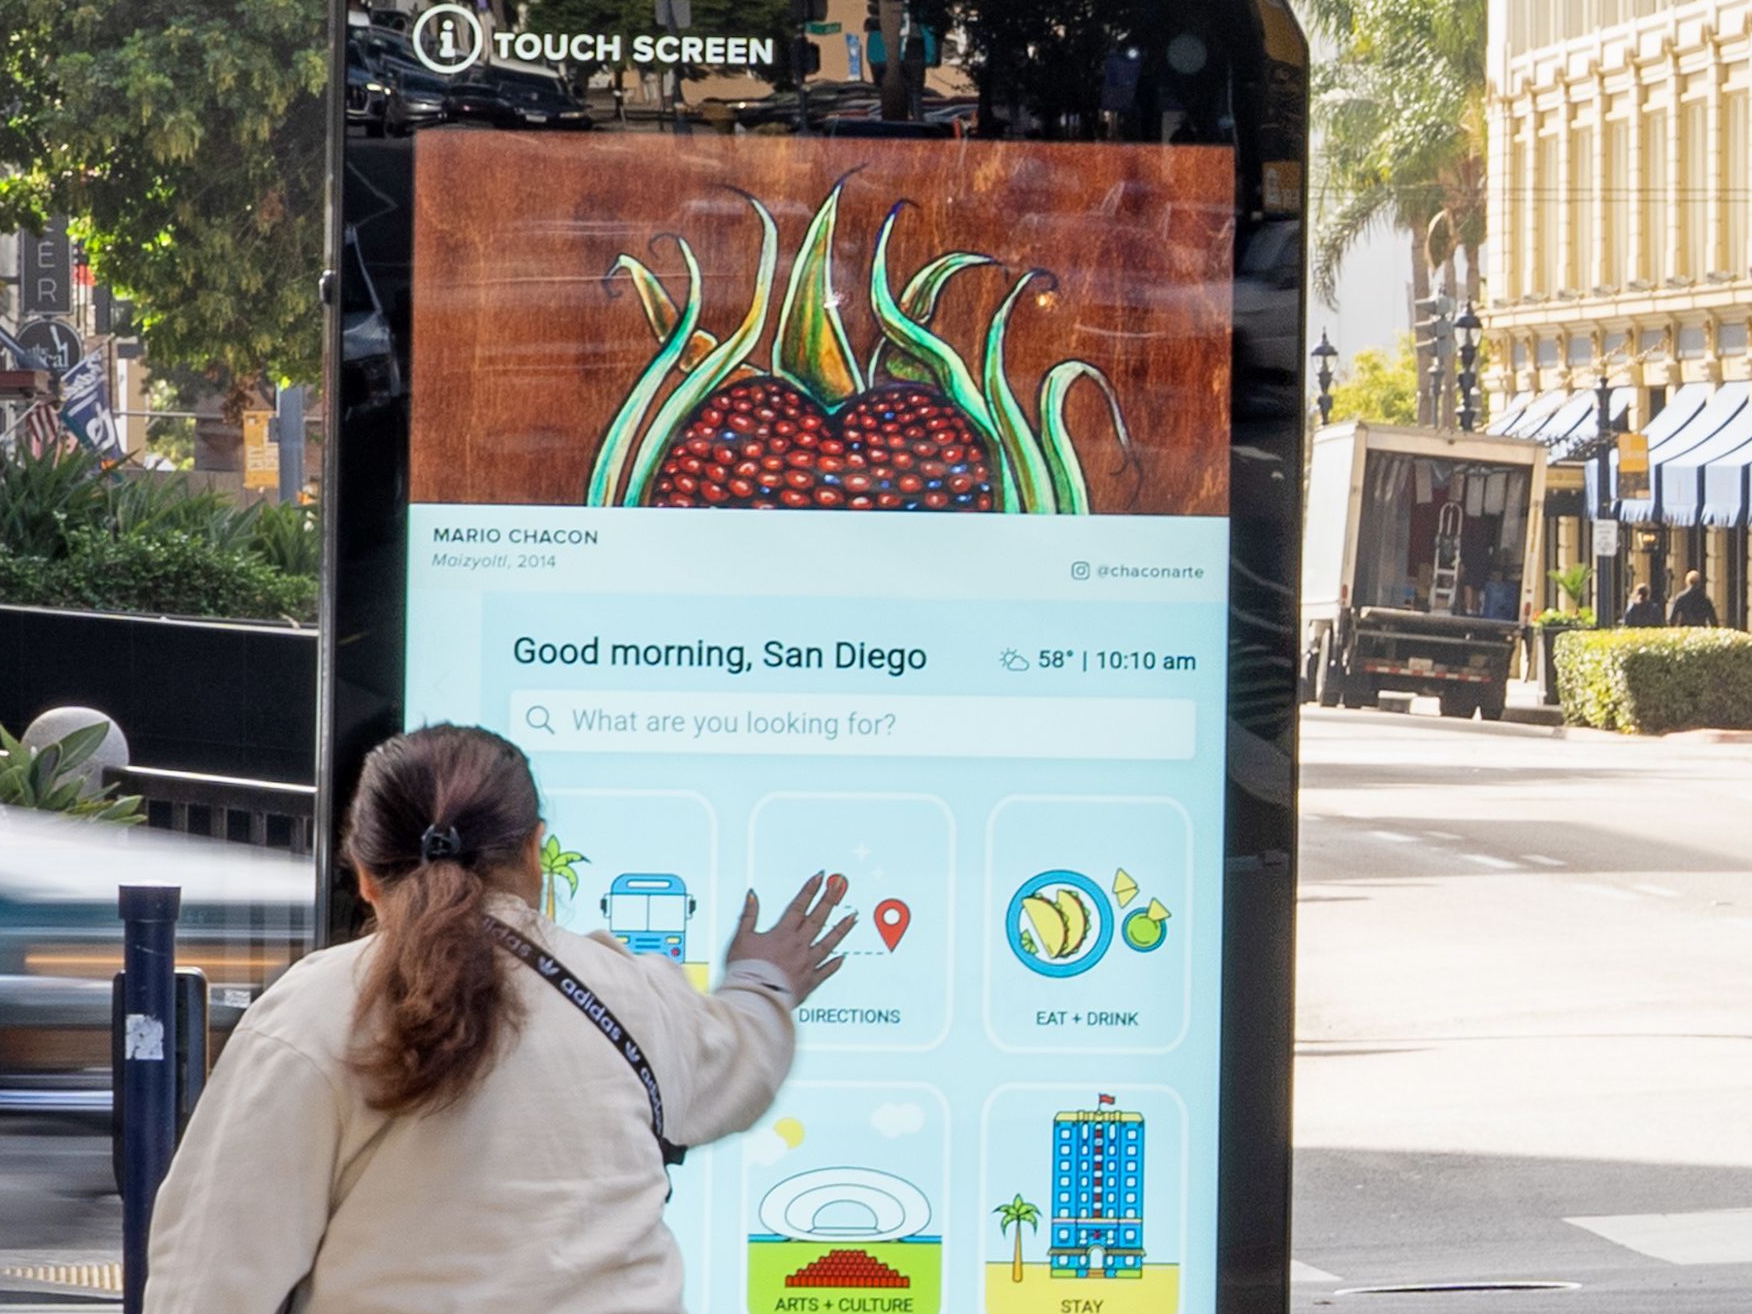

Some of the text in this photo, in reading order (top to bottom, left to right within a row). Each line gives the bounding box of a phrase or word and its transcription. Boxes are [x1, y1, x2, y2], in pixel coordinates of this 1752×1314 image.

[494, 32, 774, 66] TOUCH SCREEN
[433, 527, 598, 544] MARIO CHACON
[517, 554, 557, 569] 2014
[1097, 563, 1205, 580] @chaconarte
[513, 636, 928, 677] Good morning, San Diego
[1038, 649, 1075, 669] 58°
[1097, 651, 1156, 670] 10:10
[1162, 655, 1197, 671] am
[572, 707, 897, 743] What are you looking for?
[560, 976, 624, 1043] adidas
[798, 1008, 901, 1024] DIRECTIONS
[1036, 1011, 1068, 1026] EAT
[1086, 1012, 1139, 1027] DRINK
[774, 1297, 819, 1313] ARTS
[838, 1298, 914, 1313] CULTURE
[1060, 1300, 1104, 1314] STAY
